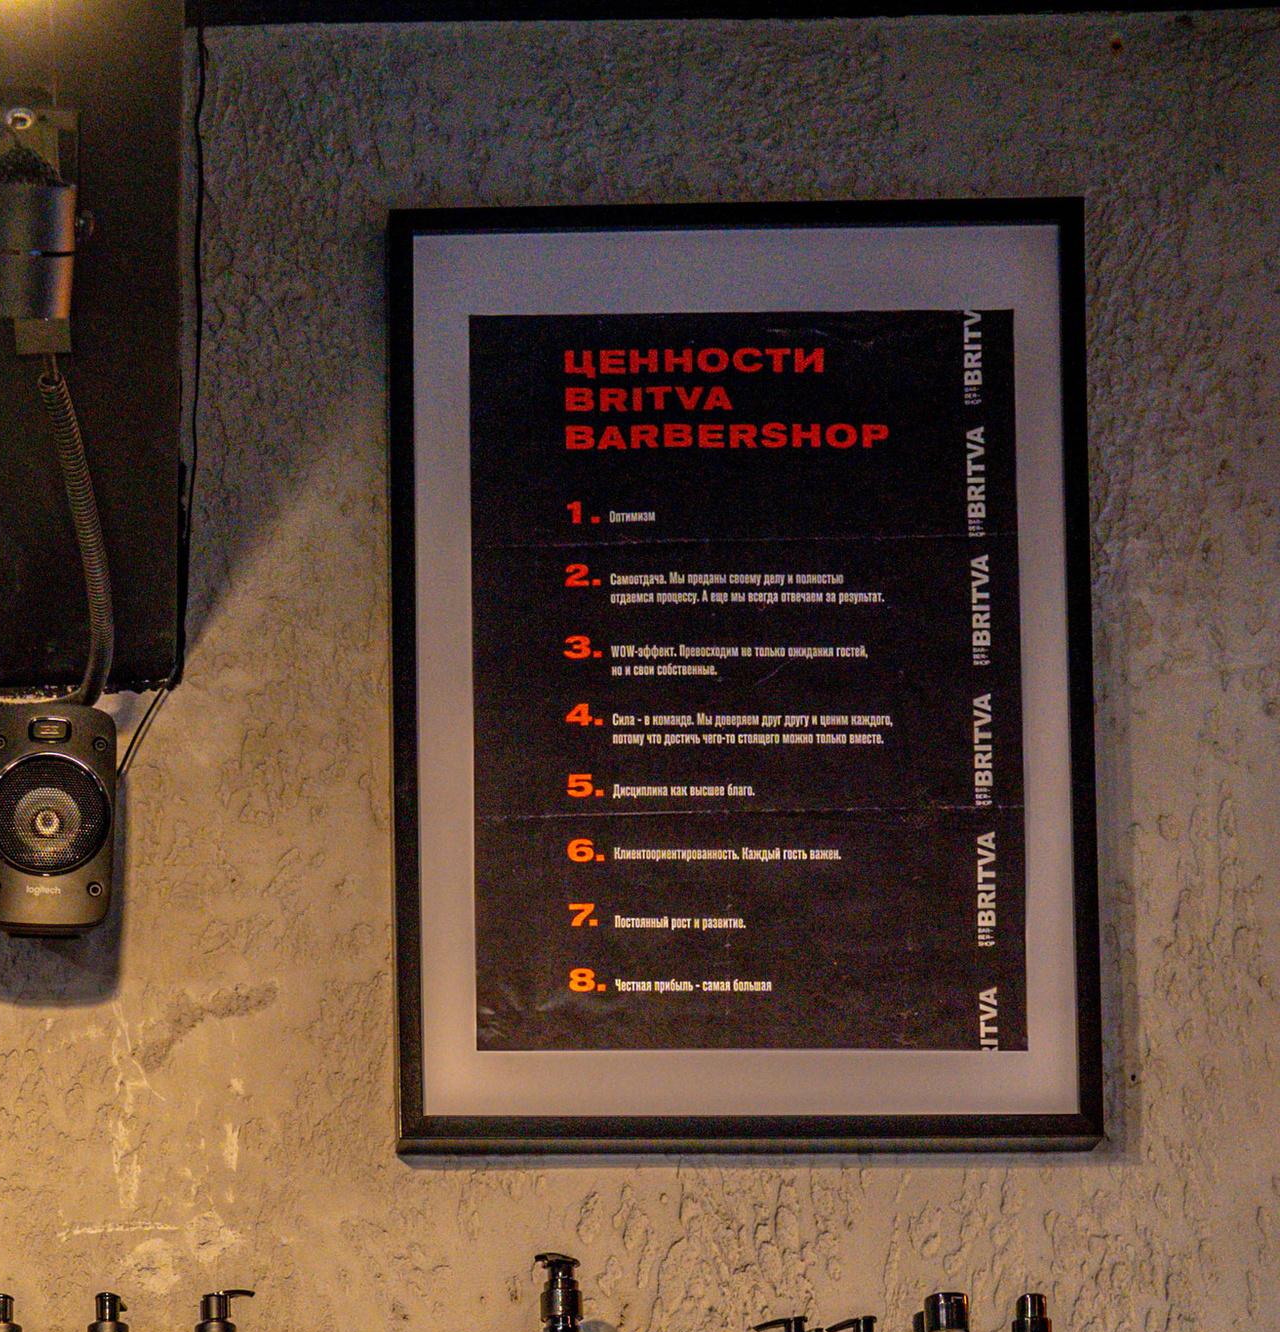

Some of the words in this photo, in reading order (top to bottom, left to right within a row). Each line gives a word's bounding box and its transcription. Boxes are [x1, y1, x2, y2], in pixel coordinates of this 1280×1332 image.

[564, 348, 824, 379] ЦЕННОСТИ
[565, 386, 733, 411] BRITVA
[565, 423, 889, 450] BARBERSHOP
[967, 426, 985, 519] BRITVA
[566, 501, 600, 524] 1.
[610, 510, 655, 523] Оптимизм
[565, 564, 601, 587] 2.
[971, 554, 990, 646] BRITVA
[564, 636, 602, 659] 3.
[565, 703, 603, 726] 4.
[973, 693, 992, 786] BRITVA
[567, 774, 603, 797] 5.
[613, 784, 668, 798] Дисциплина
[670, 785, 687, 796] как
[690, 785, 725, 796] высшее
[728, 784, 754, 796] благо.
[567, 839, 604, 862] 6.
[614, 847, 739, 861] Клиентоориентированность.
[742, 847, 780, 861] Каждый
[783, 848, 807, 860] гость
[810, 848, 841, 860] важен.
[26, 885, 60, 896] logitech
[977, 831, 995, 926] BRITVA
[569, 903, 598, 926] 7.
[615, 915, 668, 928] Постоянный
[671, 917, 691, 930] рост
[694, 917, 699, 928] и
[702, 917, 745, 930] развитие.
[569, 968, 606, 992] 8.
[615, 979, 651, 991] Честная
[655, 979, 693, 993] прибыль
[703, 980, 731, 991] самая
[733, 979, 772, 991] большая
